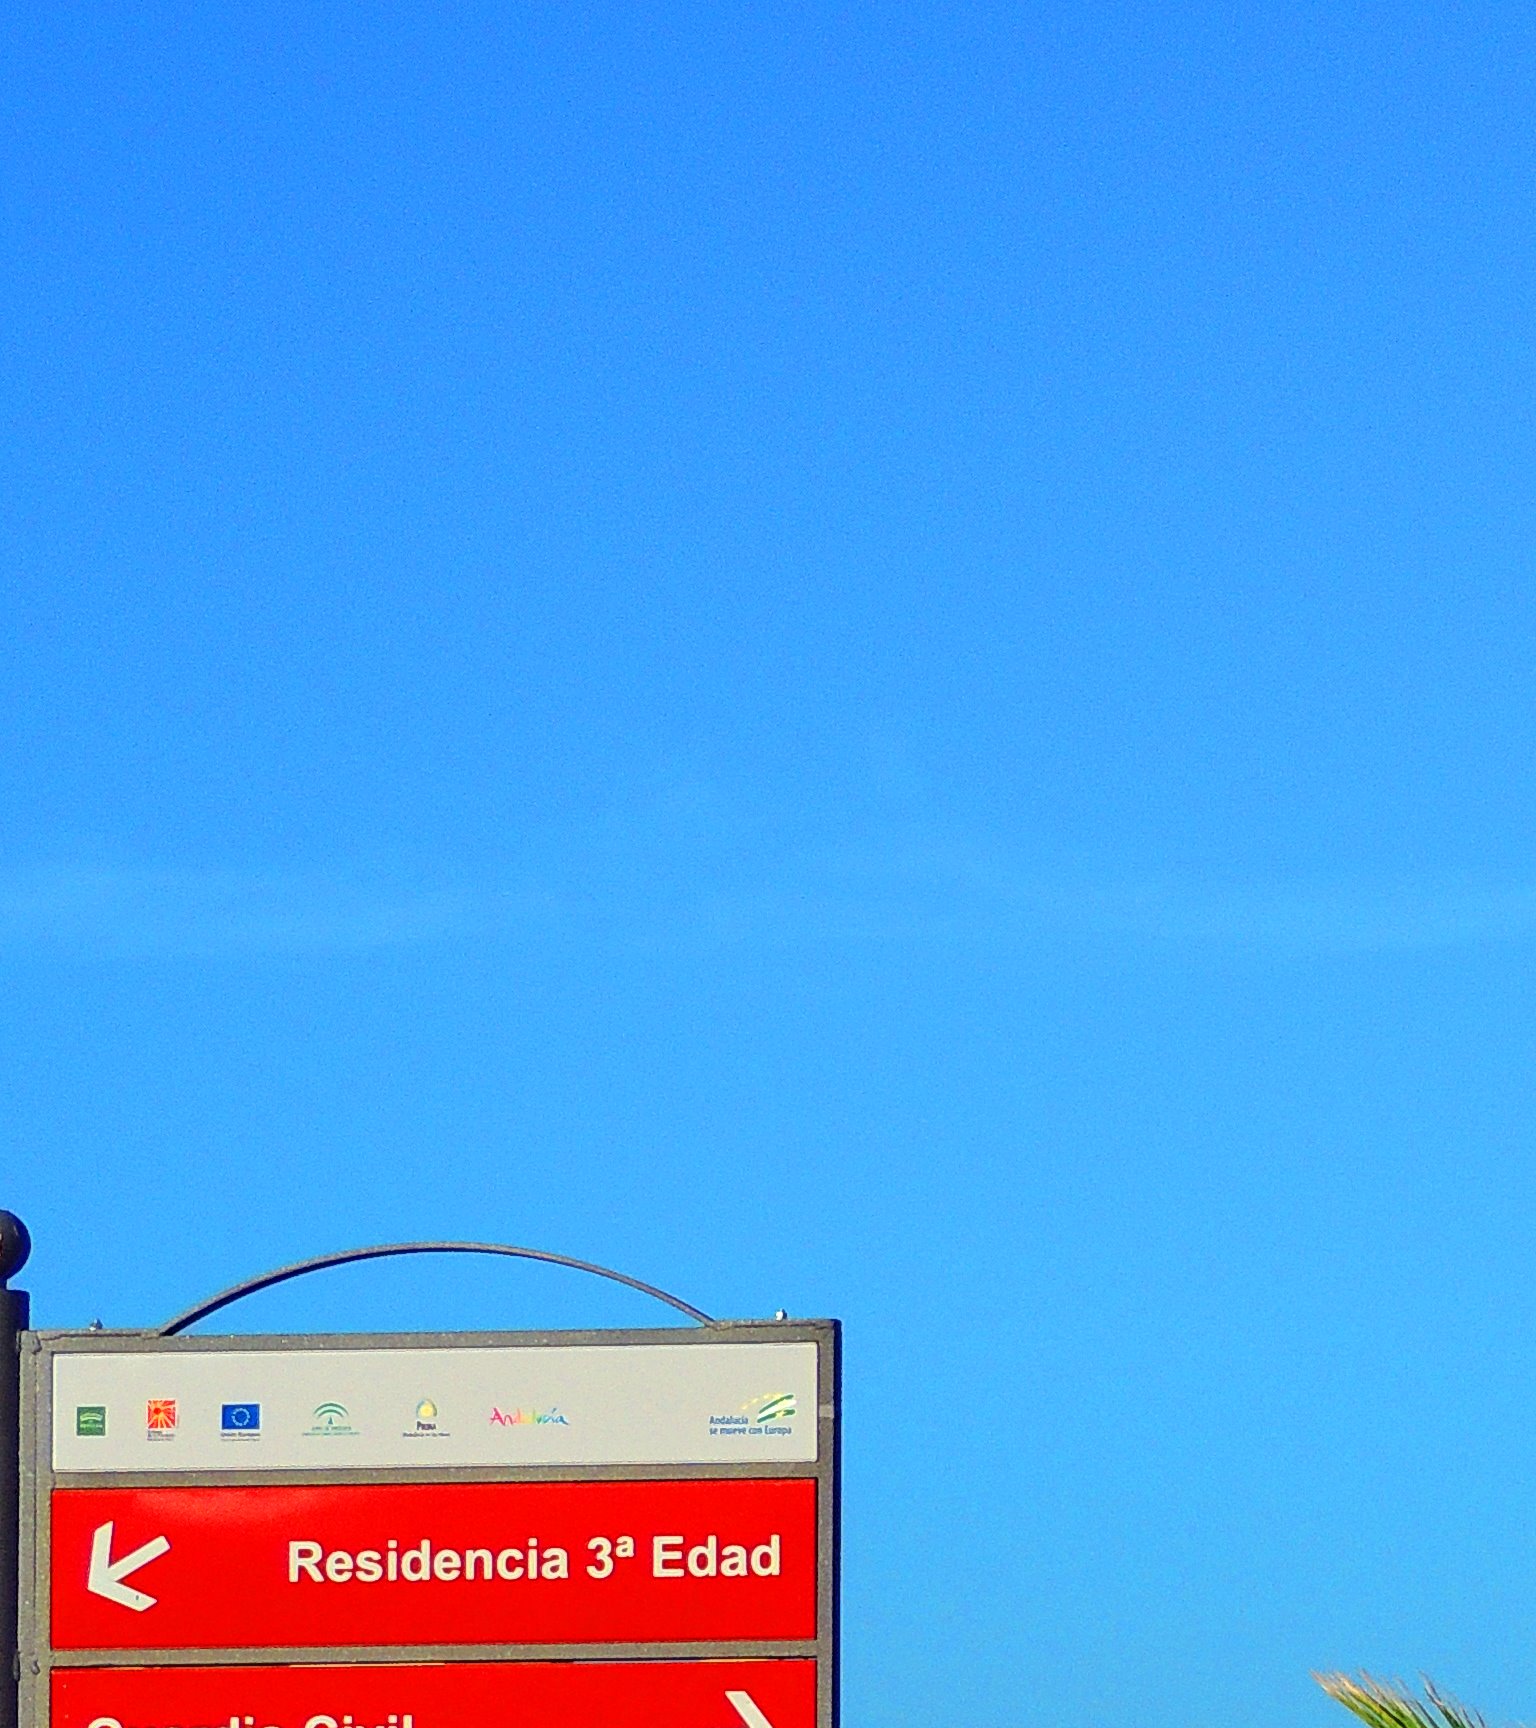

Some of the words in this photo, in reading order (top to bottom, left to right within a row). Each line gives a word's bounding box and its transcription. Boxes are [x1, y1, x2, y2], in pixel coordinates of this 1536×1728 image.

[288, 1537, 569, 1583] Residencia
[586, 1535, 635, 1579] 3ª
[652, 1534, 781, 1578] Edad
